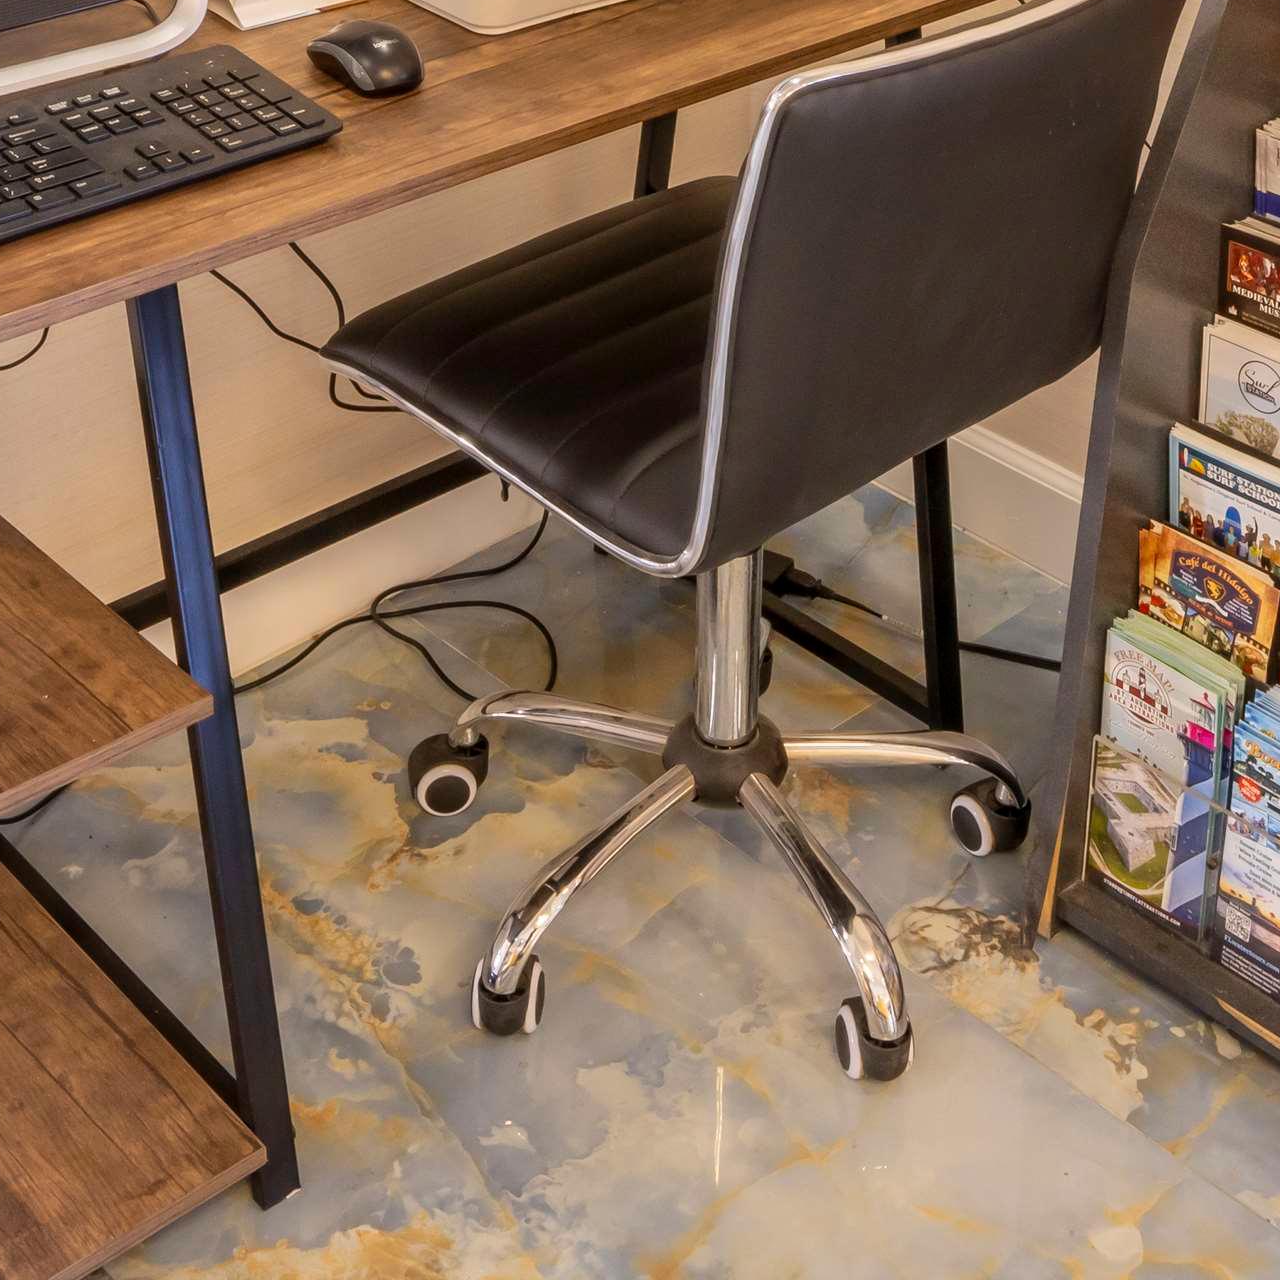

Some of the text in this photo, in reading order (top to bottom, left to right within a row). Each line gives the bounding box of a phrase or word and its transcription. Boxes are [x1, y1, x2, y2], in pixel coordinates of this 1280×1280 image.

[1178, 557, 1254, 606] Café del Hidalgo
